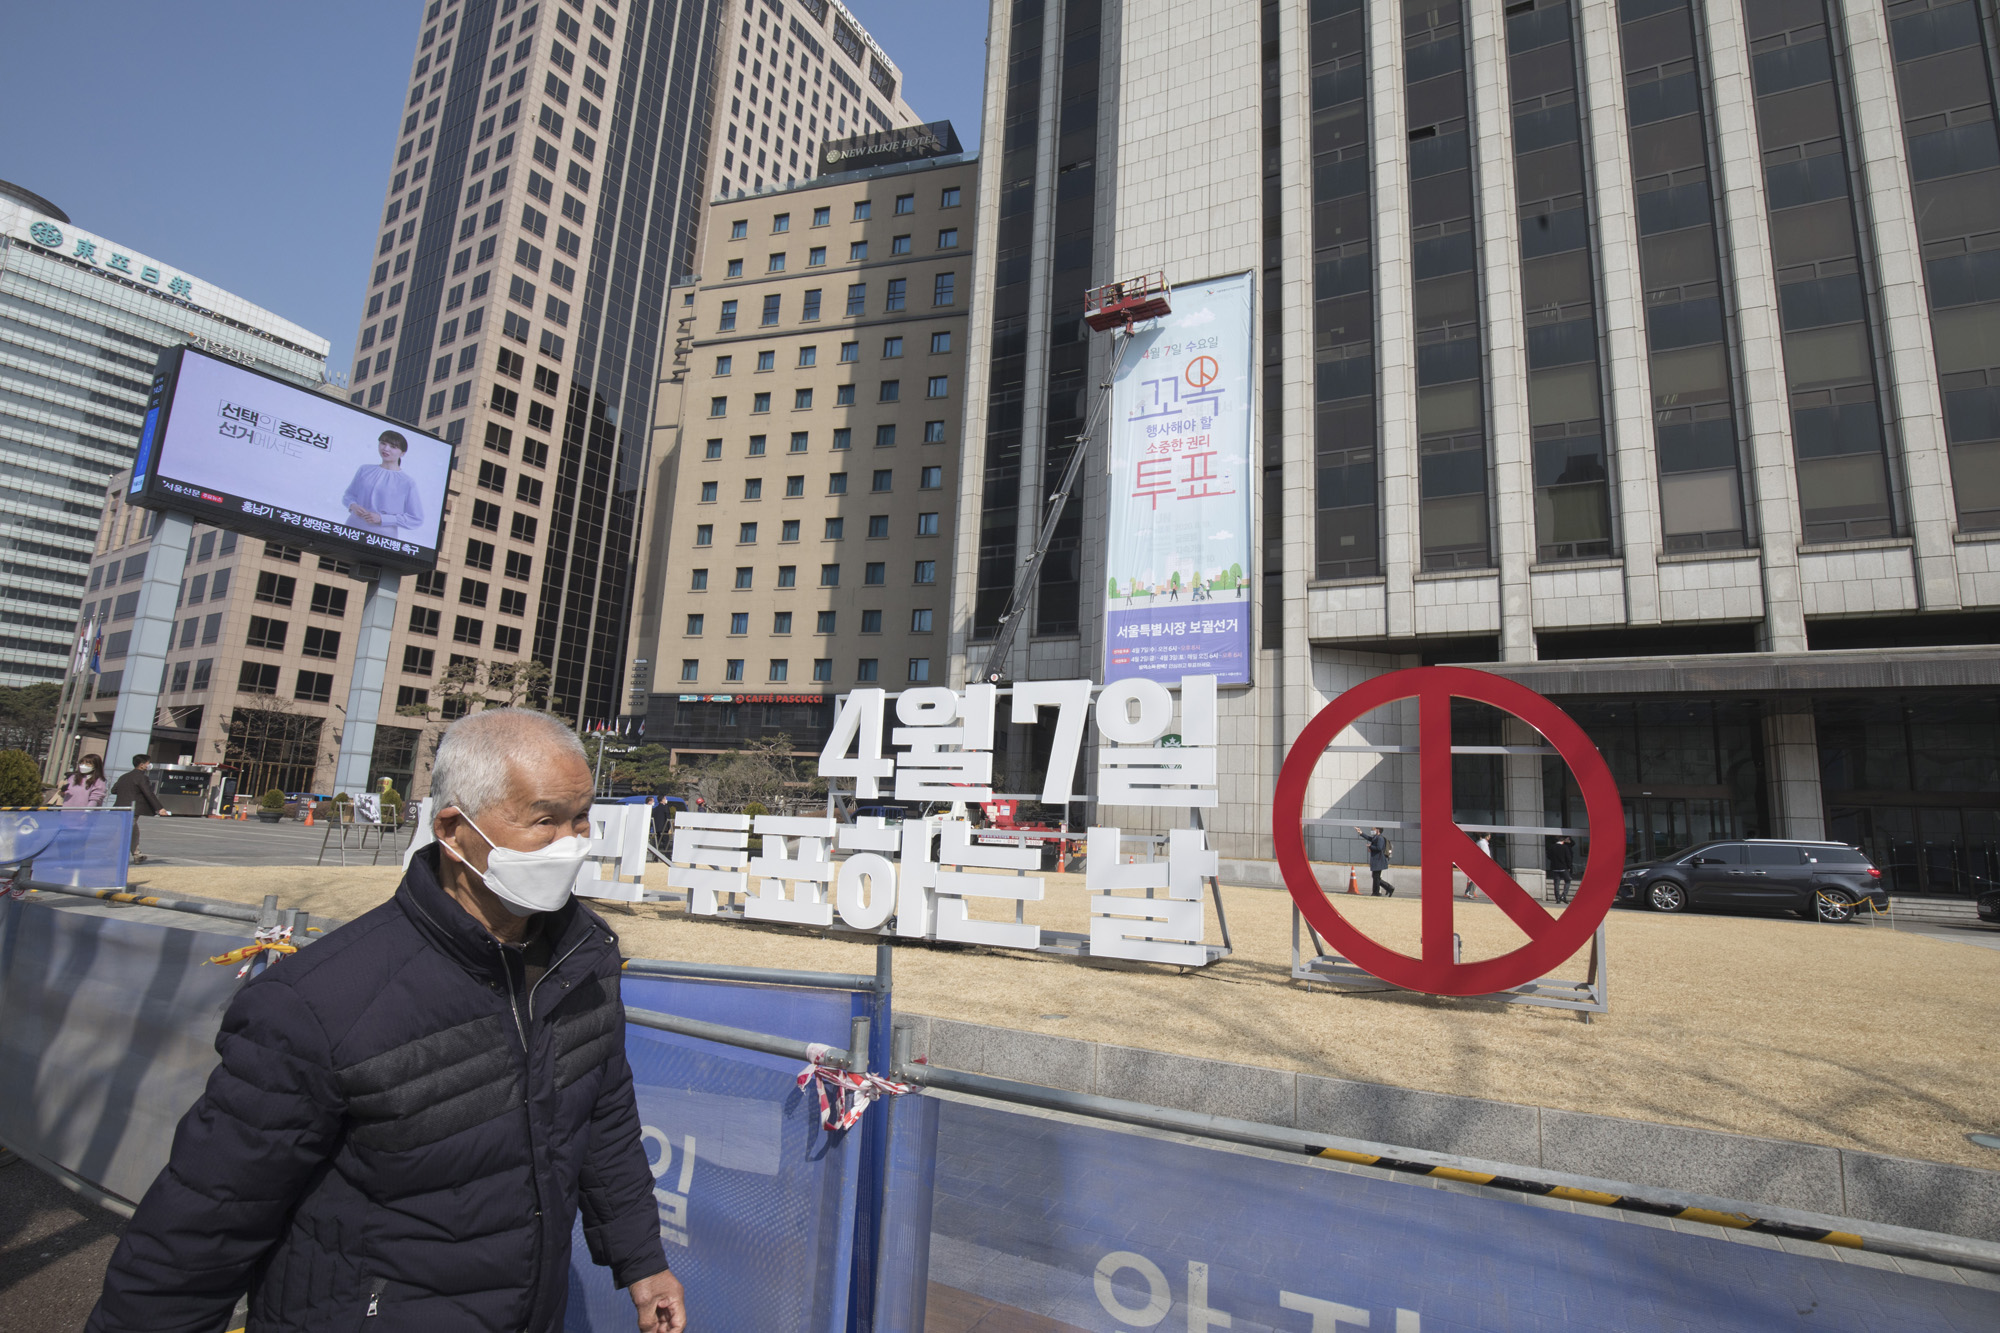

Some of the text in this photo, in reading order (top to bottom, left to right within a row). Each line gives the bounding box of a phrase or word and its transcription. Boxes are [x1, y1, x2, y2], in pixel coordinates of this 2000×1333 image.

[864, 31, 894, 72] CENTER
[840, 134, 939, 160] NEW KUKJE HOTEL
[73, 238, 192, 300] 東亞日報
[191, 336, 256, 367] 서울신문
[1142, 336, 1219, 360] 4월 7일 수요일
[218, 421, 303, 460] 선거에서도
[222, 403, 330, 450] 선택의 중요성
[1146, 415, 1213, 438] 행사해야 할
[1146, 434, 1210, 455] 소중한 권리
[164, 480, 201, 498] 서울신문
[1131, 450, 1236, 511] 투표
[242, 501, 274, 519] 홍남기
[1116, 618, 1239, 639] 서울특별시장 보궐선거
[745, 692, 824, 704] CAFFÉ PASCUCCI
[818, 674, 1219, 808] 4월 7일
[666, 811, 1045, 950] 투표하는
[1086, 828, 1220, 967] 날
